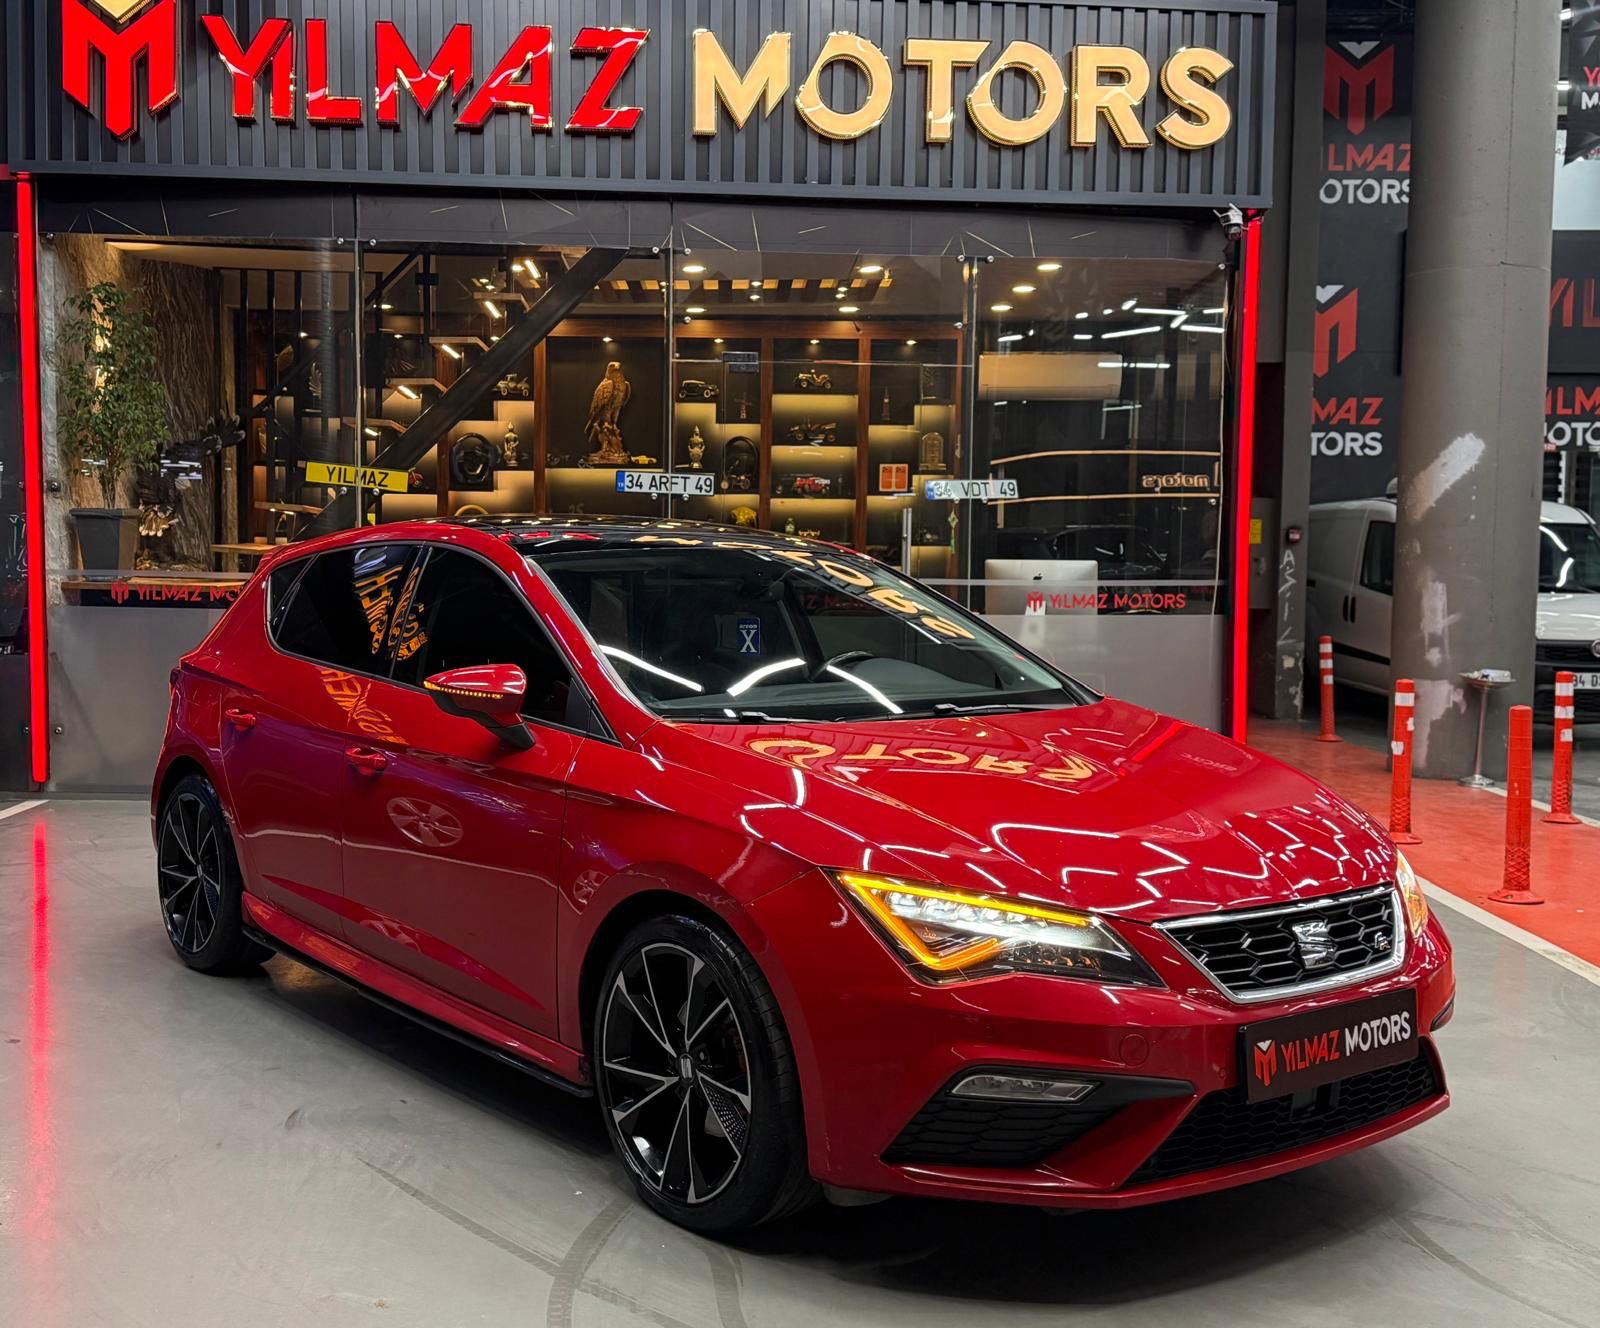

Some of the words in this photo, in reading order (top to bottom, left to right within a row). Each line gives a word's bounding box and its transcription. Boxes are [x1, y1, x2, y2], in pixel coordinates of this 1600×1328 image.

[201, 14, 651, 135] YILMAZ
[692, 28, 1235, 151] MOTORS
[1581, 91, 1600, 110] M
[1544, 421, 1600, 447] OTO
[326, 465, 389, 488] YILMAZ
[626, 473, 643, 490] 34
[695, 477, 713, 493] 49
[1000, 481, 1016, 497] 49
[137, 584, 204, 601] YILMAZ
[1048, 593, 1108, 609] YILMAZ
[1114, 593, 1186, 609] MOTORS
[1591, 674, 1600, 687] D
[1281, 1030, 1340, 1073] YILMAZ
[1344, 1011, 1411, 1057] MOTORS
